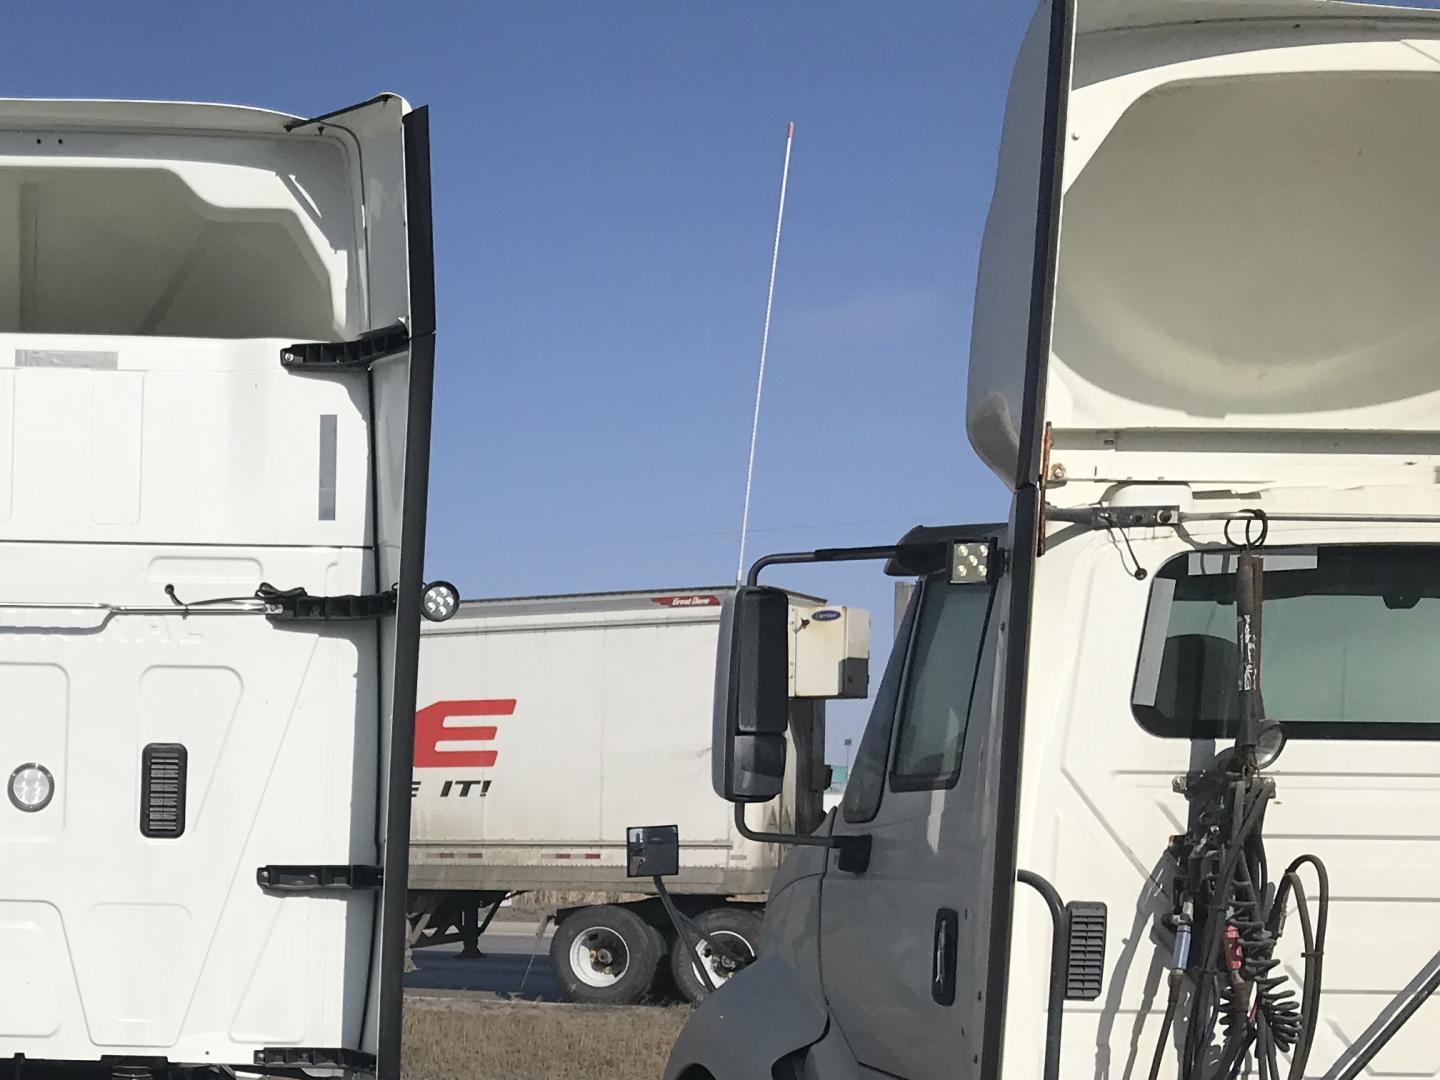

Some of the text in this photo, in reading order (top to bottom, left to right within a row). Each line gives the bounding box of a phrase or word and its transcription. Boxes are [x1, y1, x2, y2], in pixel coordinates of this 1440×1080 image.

[672, 596, 711, 606] Great Dane
[440, 780, 492, 798] IT!
